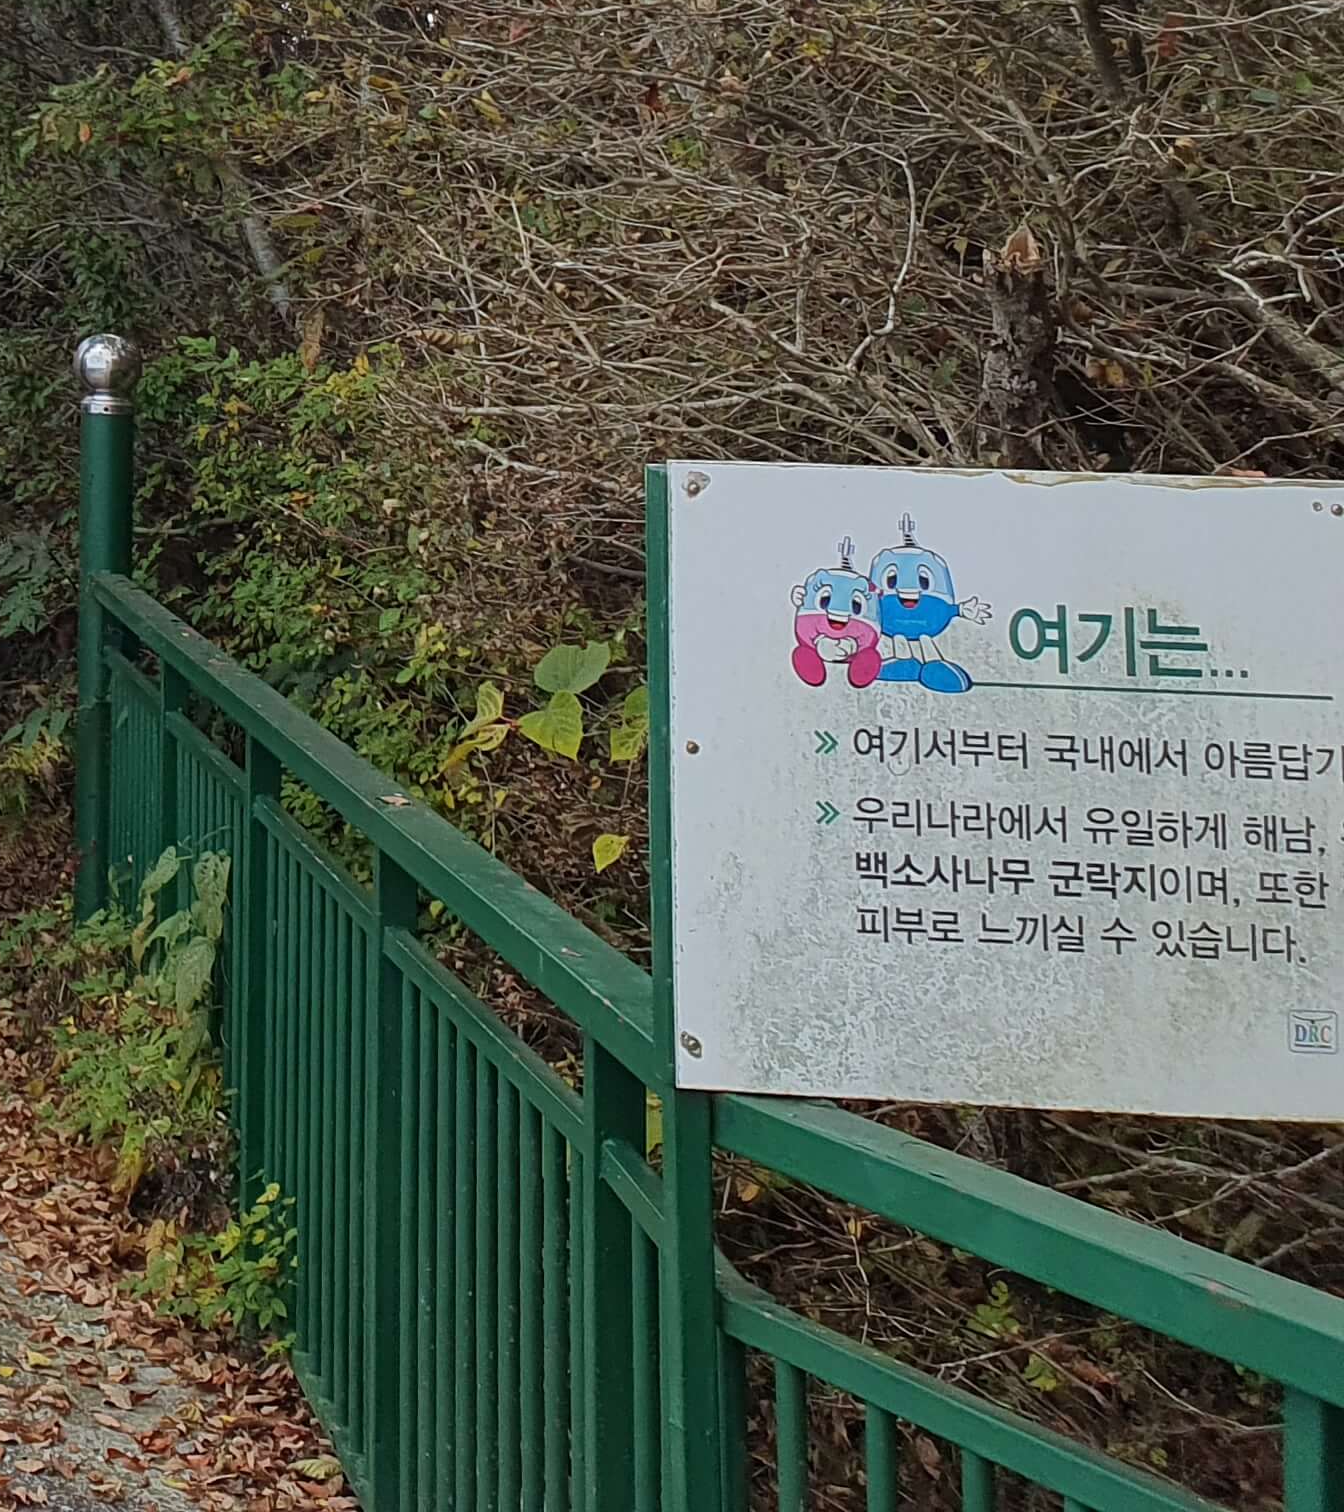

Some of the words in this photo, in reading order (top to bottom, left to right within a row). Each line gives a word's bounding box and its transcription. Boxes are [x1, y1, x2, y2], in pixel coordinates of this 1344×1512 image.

[1009, 603, 1249, 680] 여기는...
[852, 727, 1029, 771] 여기서부터
[1044, 733, 1189, 777] 국내에서
[852, 796, 1068, 844] 우리나라에서
[1082, 805, 1228, 848] 유일하게
[1243, 811, 1328, 858] 해남,
[854, 853, 1034, 897] 백소사나무
[1047, 859, 1241, 907] 군락지이며,
[1254, 870, 1328, 910] 또한
[856, 904, 965, 946] 피부로
[977, 912, 1086, 953] 느끼실
[1100, 918, 1137, 952] 수
[1151, 920, 1308, 964] 있습니다.
[1294, 1023, 1332, 1044] DRC
